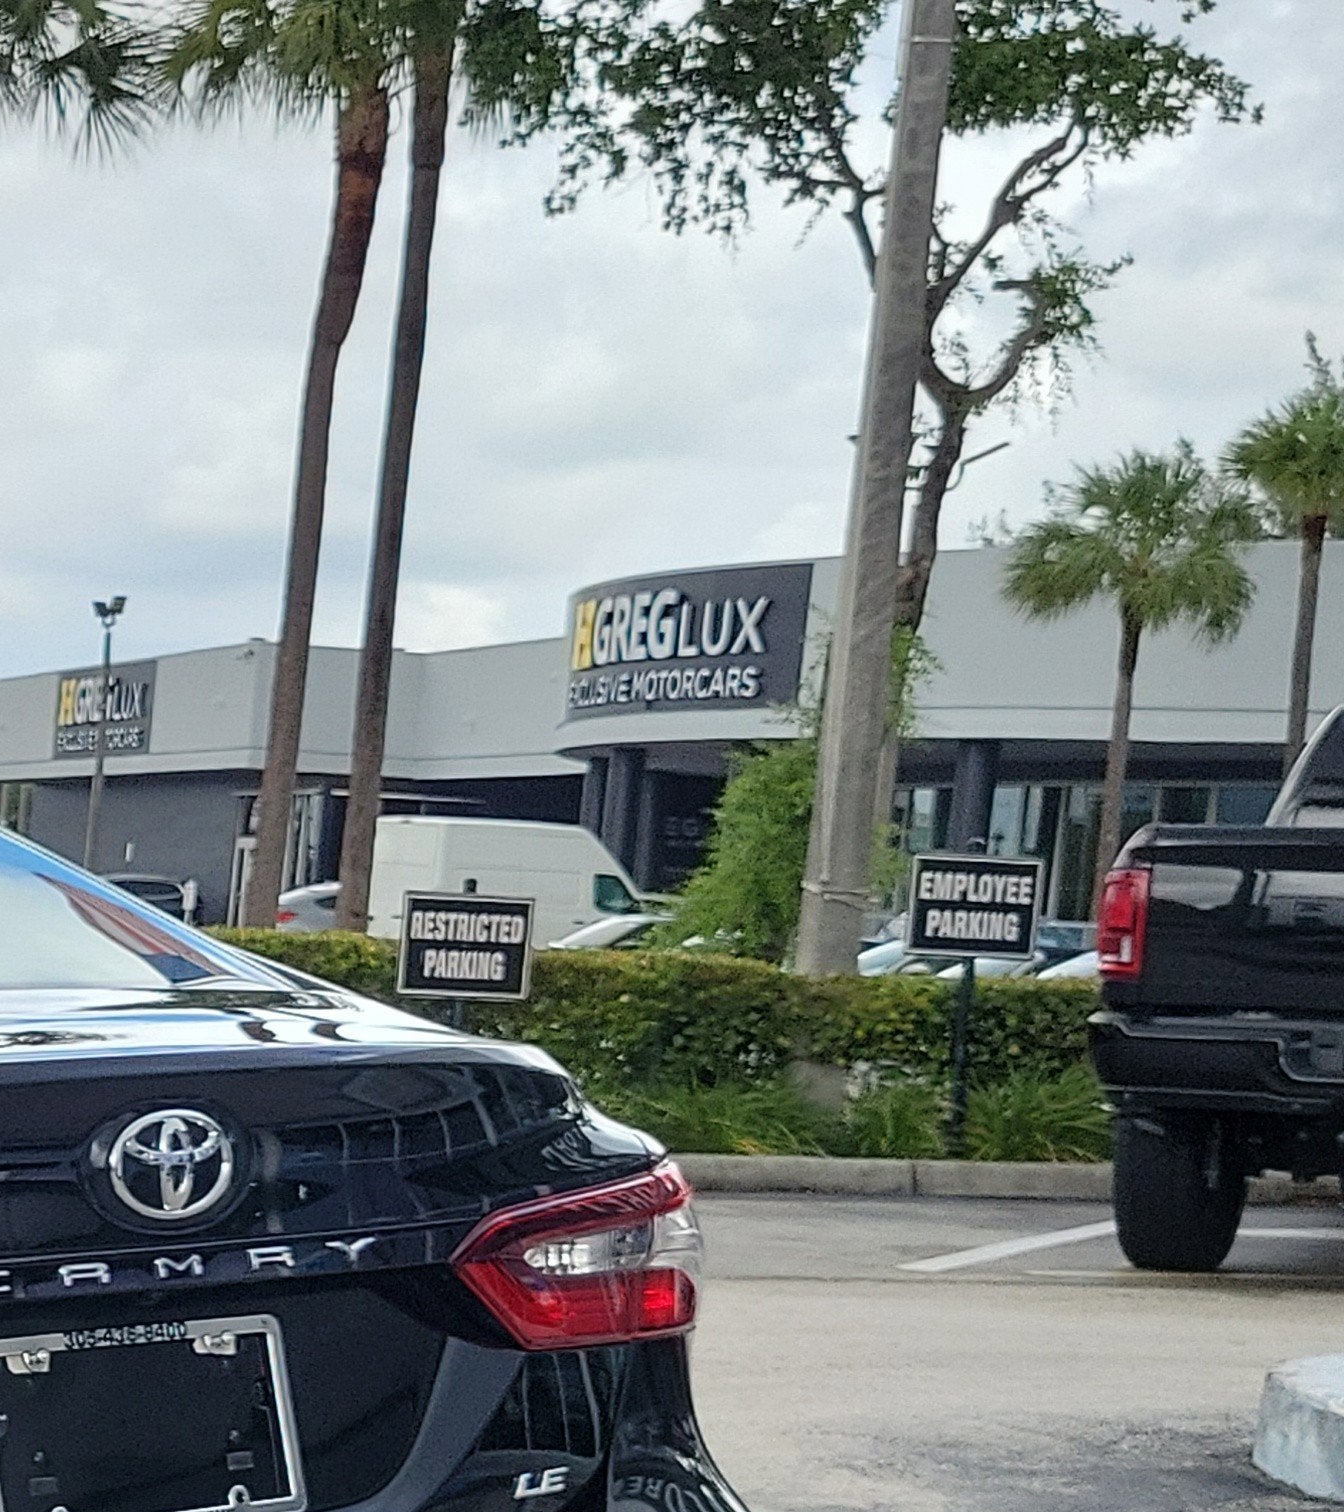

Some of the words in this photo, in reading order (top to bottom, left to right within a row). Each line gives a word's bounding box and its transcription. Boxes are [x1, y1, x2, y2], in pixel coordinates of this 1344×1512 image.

[632, 664, 760, 701] MOTORCARS
[919, 871, 1032, 905] EMPLOYEE
[410, 910, 524, 944] RESTRICTED
[925, 909, 1020, 942] PARKING
[423, 948, 506, 981] PARKING
[513, 1466, 570, 1500] LE
